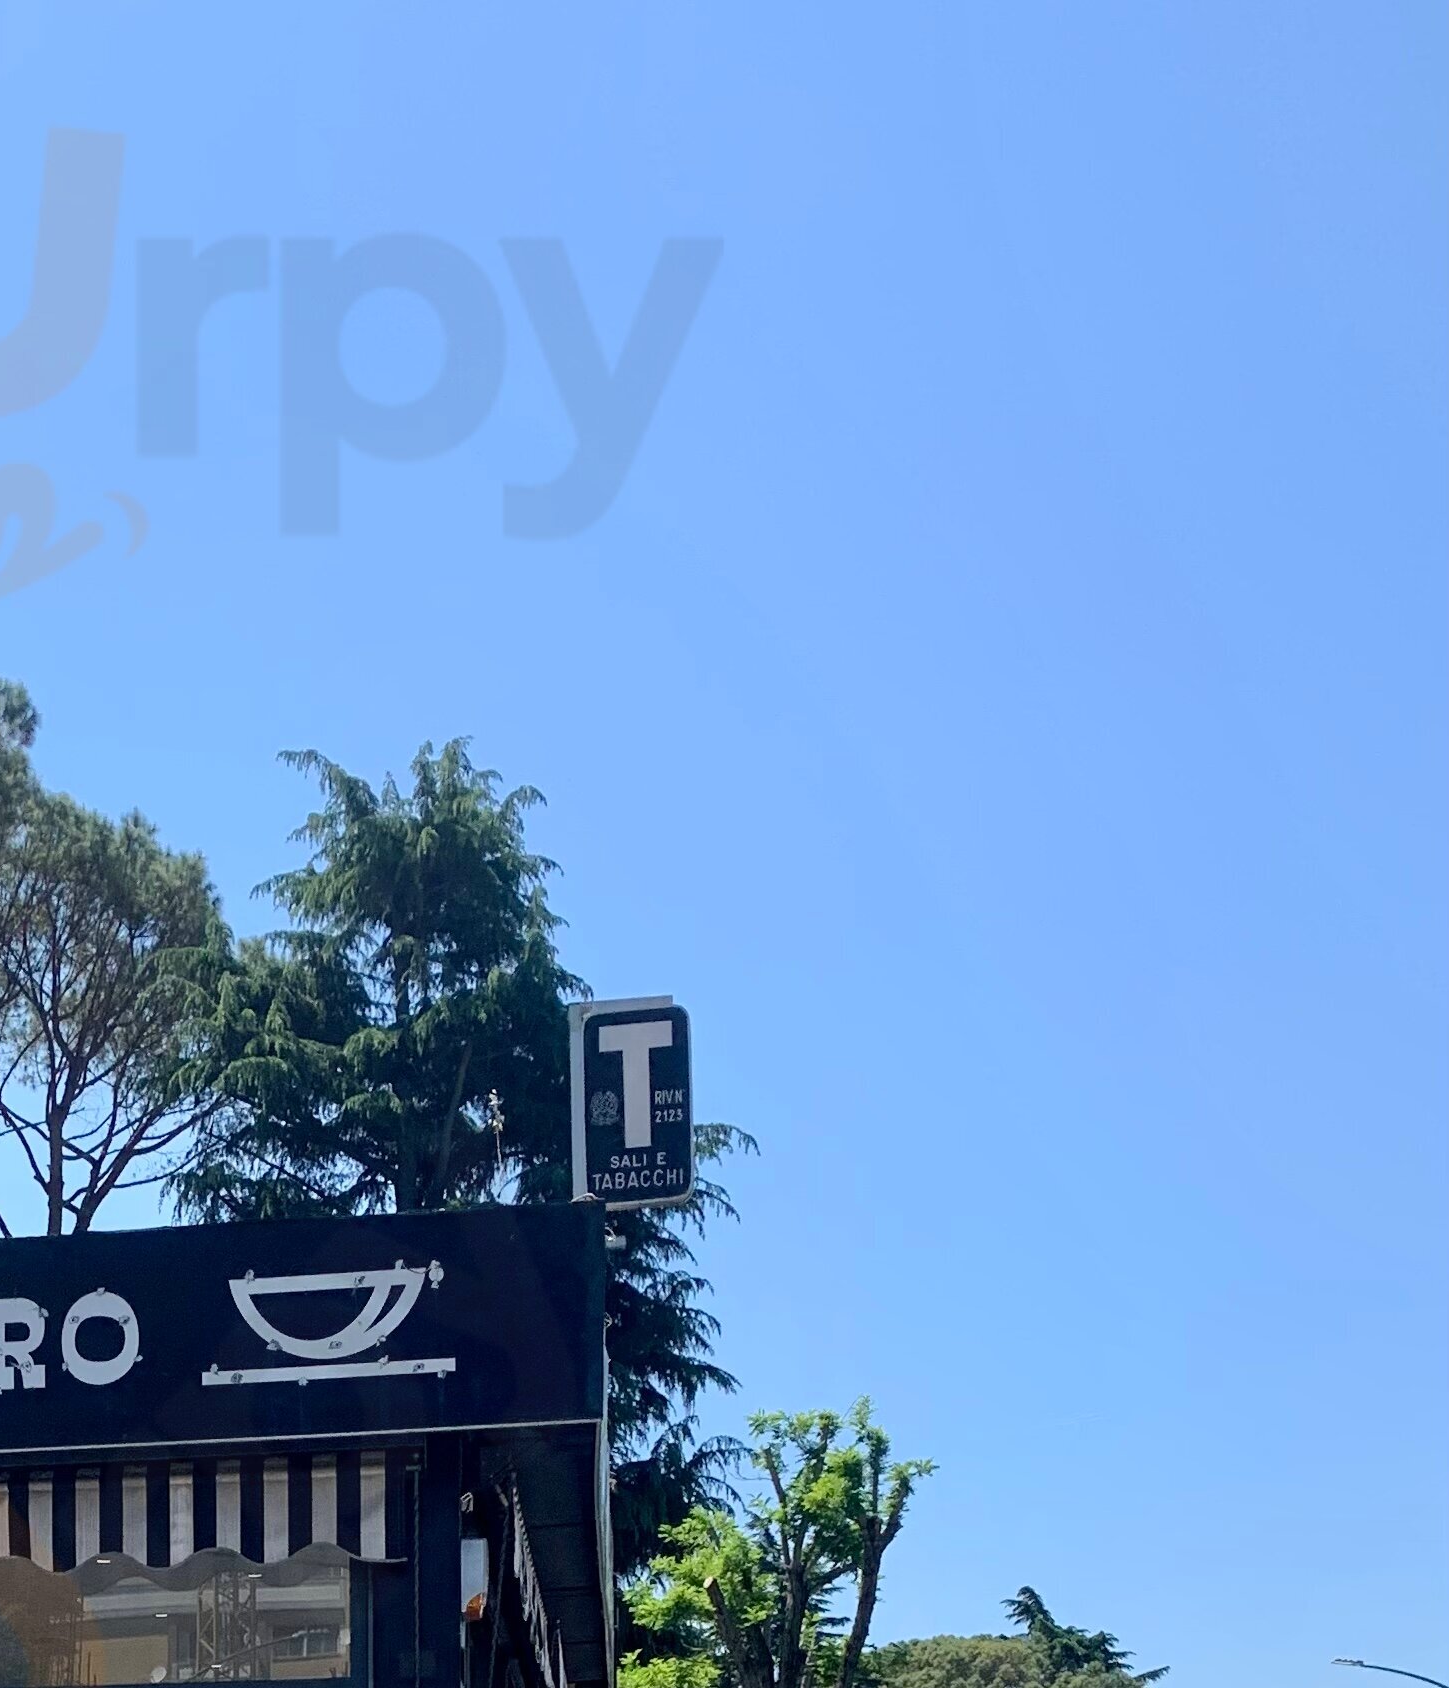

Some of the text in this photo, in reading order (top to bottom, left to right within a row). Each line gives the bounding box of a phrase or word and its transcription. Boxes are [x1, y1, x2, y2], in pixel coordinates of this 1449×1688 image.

[598, 1020, 673, 1149] T
[655, 1108, 683, 1123] 2123
[610, 1151, 667, 1169] SALI E
[592, 1168, 684, 1190] TABACCHI
